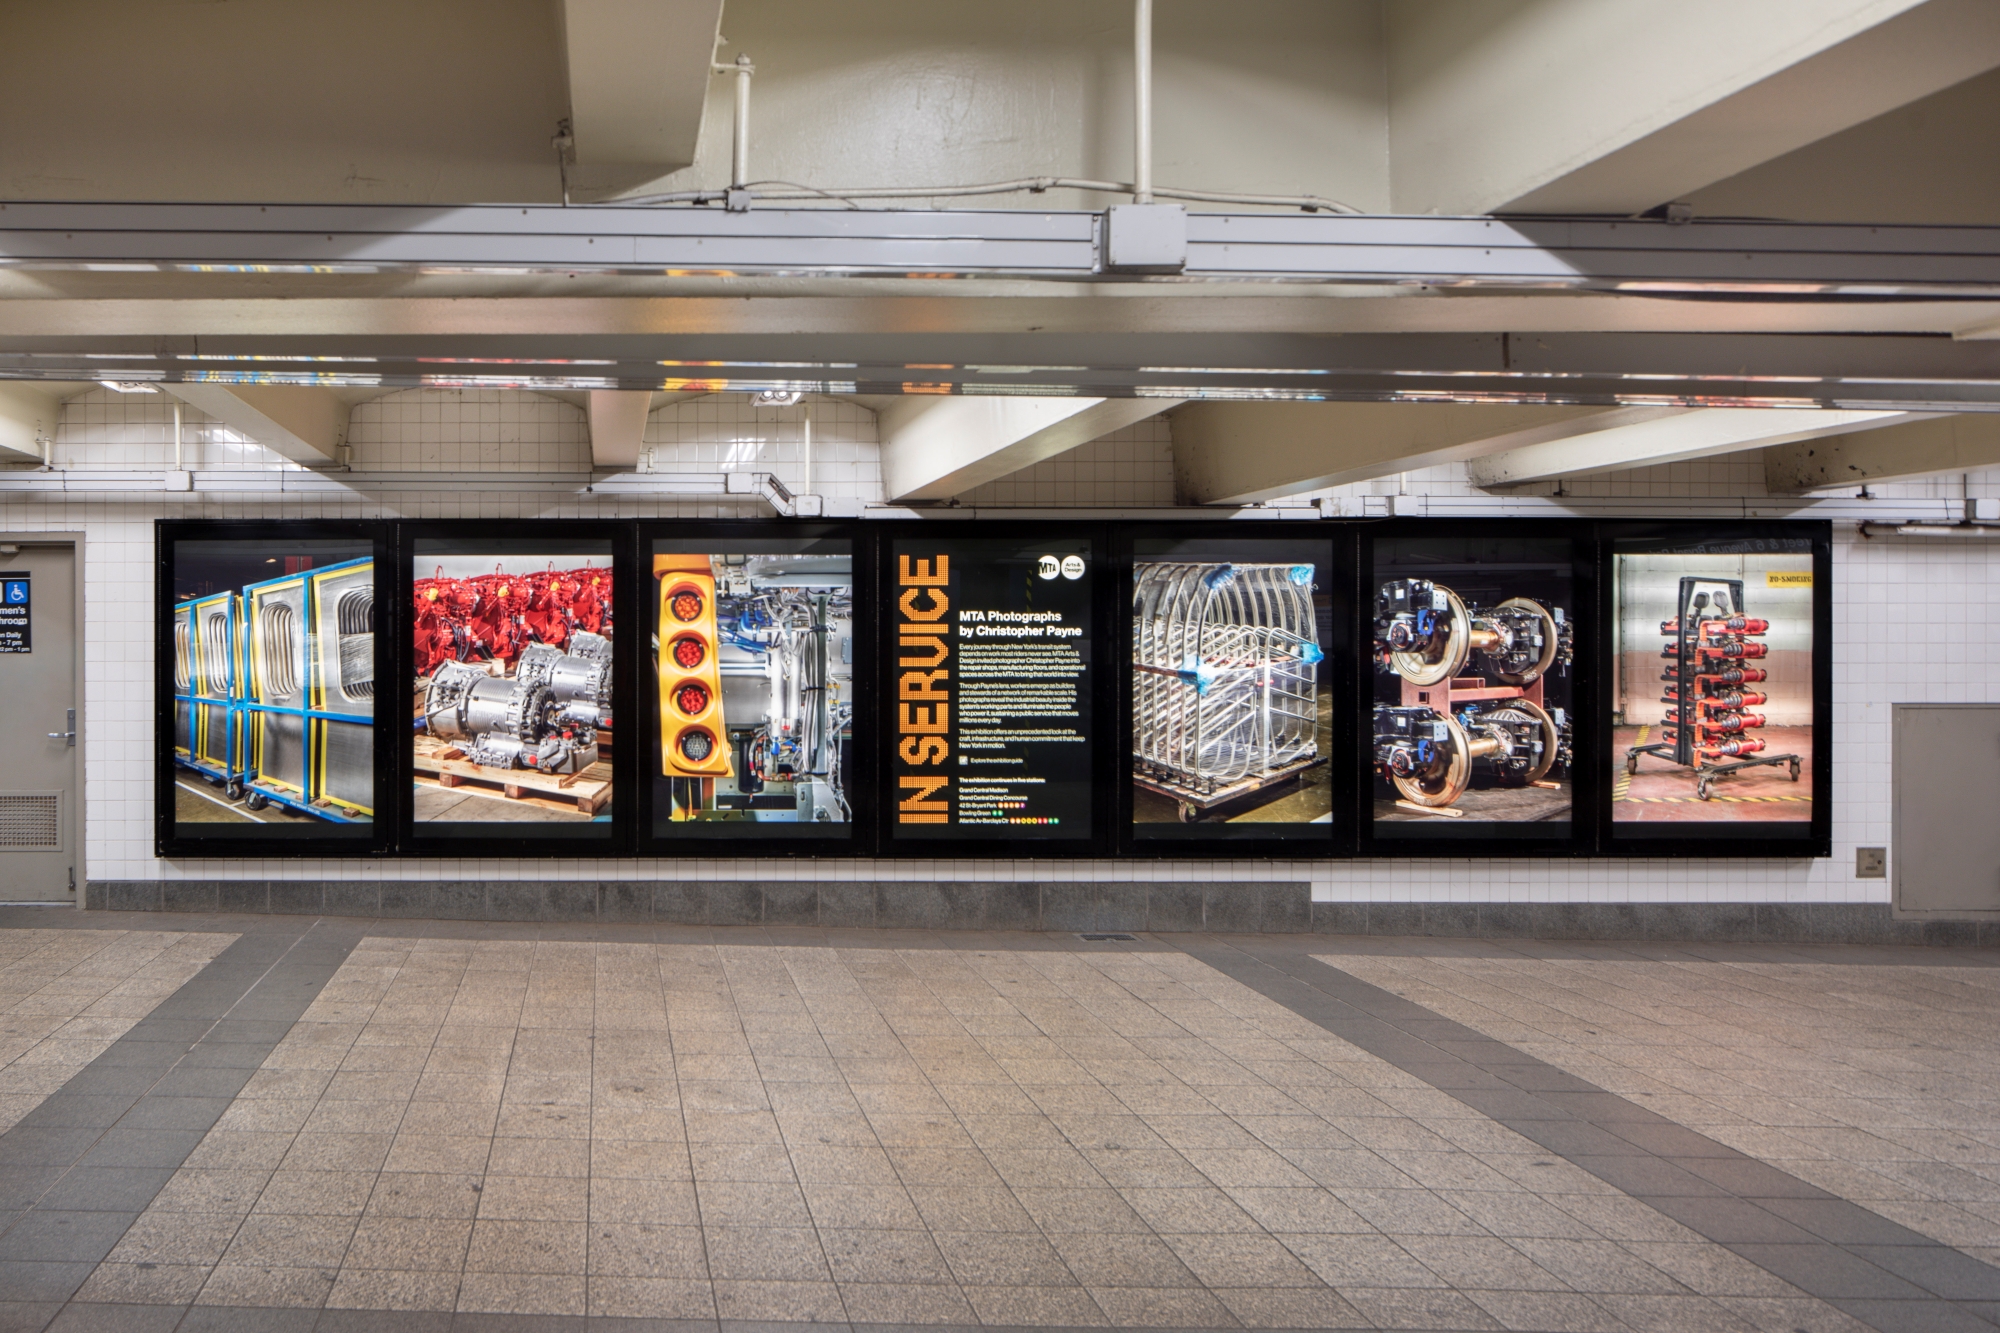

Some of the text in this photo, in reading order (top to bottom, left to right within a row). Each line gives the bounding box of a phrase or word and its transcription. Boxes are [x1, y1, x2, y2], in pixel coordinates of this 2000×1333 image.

[1038, 562, 1056, 574] MTA
[959, 610, 1061, 623] MTA Photographs
[959, 625, 1082, 638] by Christopher Payne
[899, 554, 949, 824] IN SERVICE
